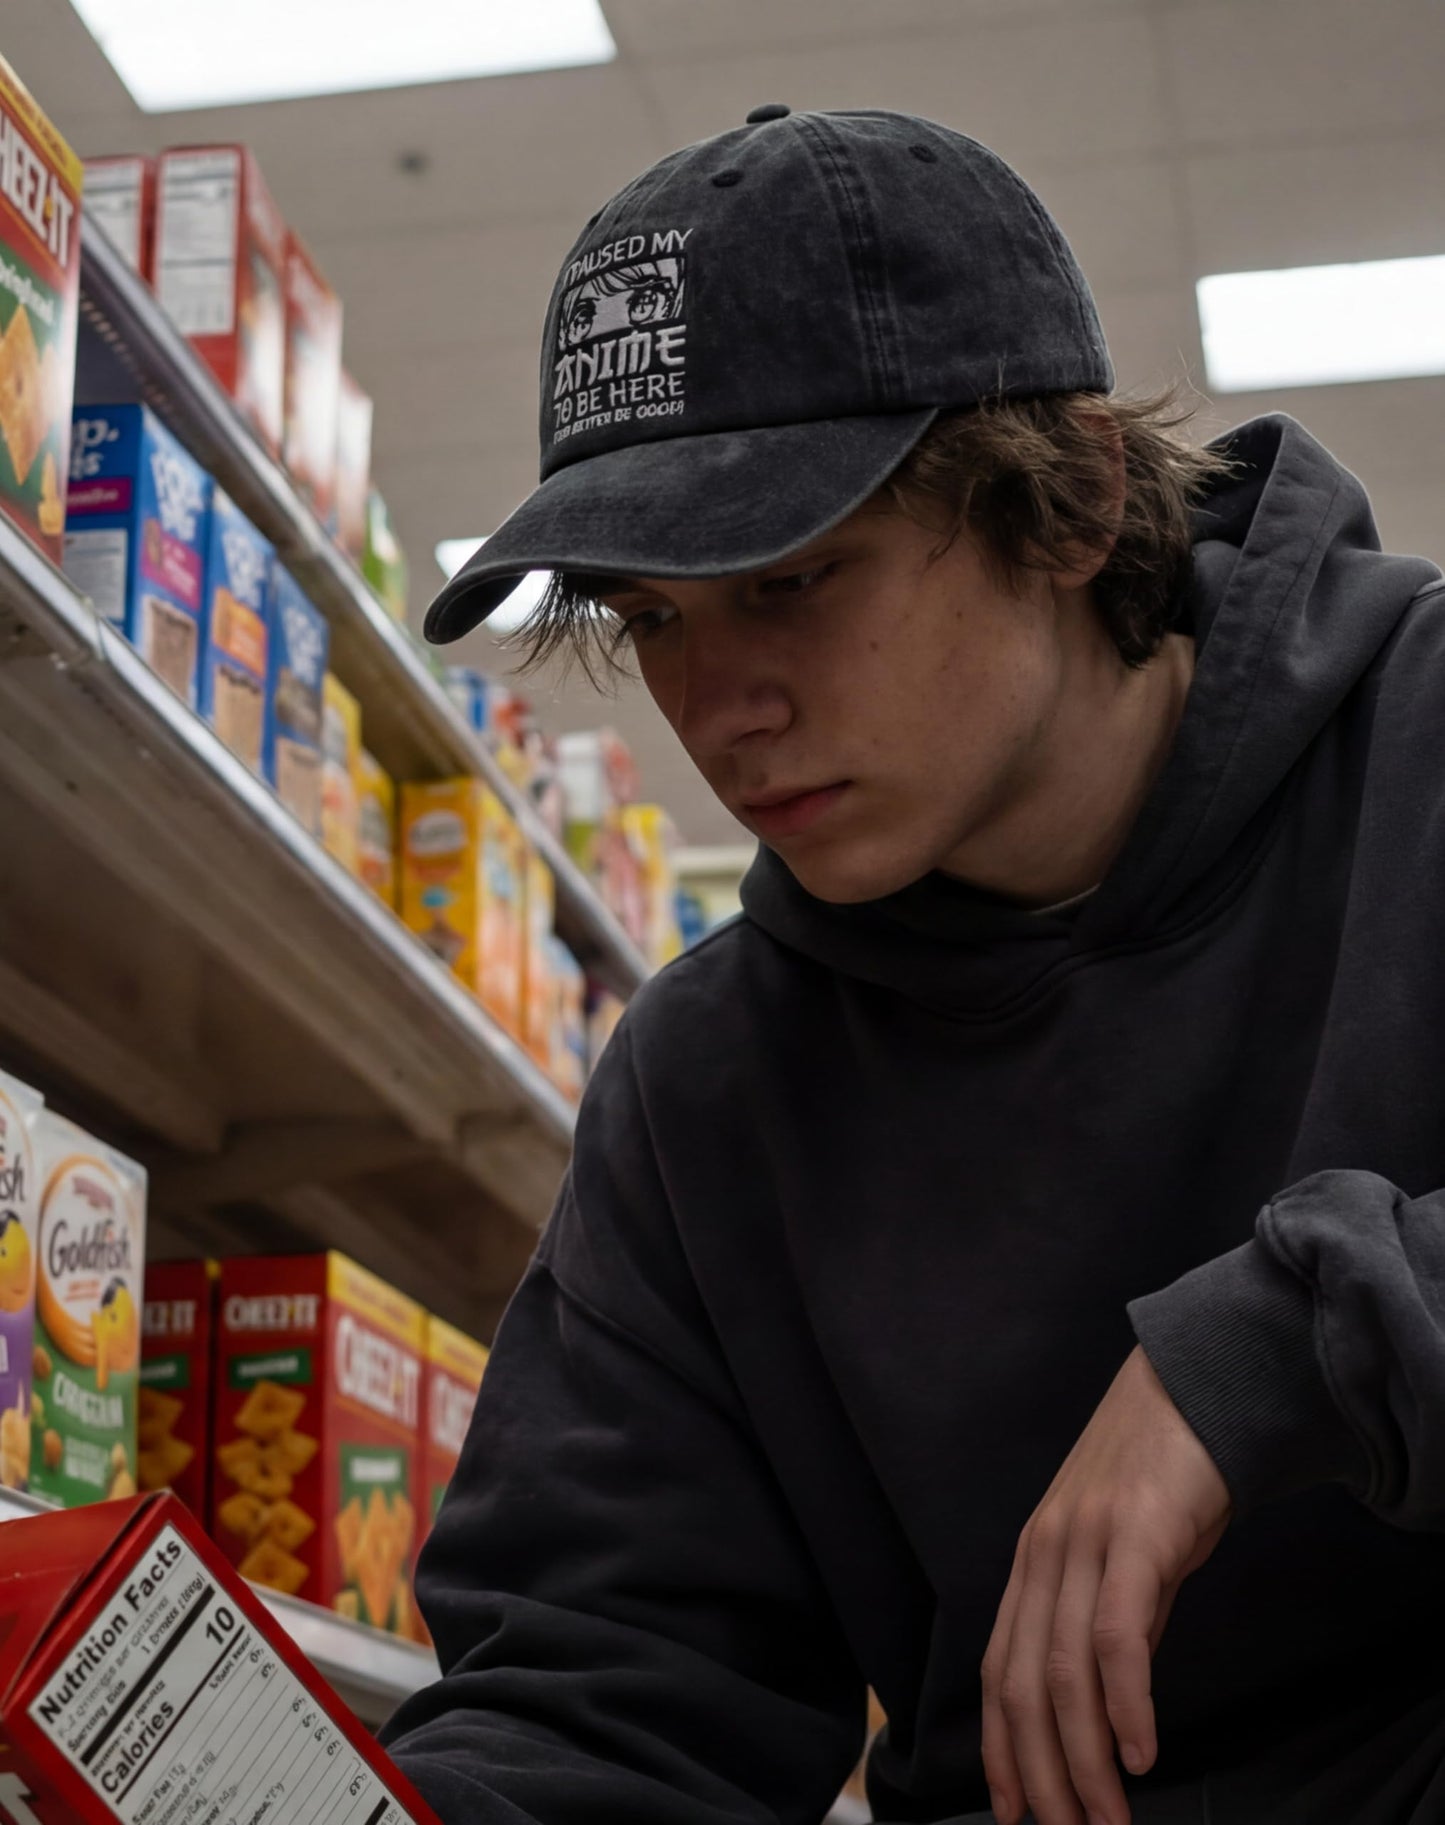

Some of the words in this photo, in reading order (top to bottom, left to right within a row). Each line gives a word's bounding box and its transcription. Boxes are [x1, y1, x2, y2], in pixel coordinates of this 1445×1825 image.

[570, 235, 645, 282] PAUSED
[650, 227, 694, 255] MY
[554, 324, 686, 400] ANIME
[553, 396, 573, 429] TO
[576, 386, 602, 418] BE
[609, 371, 686, 407] HERE
[48, 1216, 132, 1281] Goldfish
[38, 1612, 129, 1724] Nutrition
[123, 1540, 182, 1613] Facts
[101, 1701, 174, 1794] Calories
[205, 1605, 236, 1646] 10
